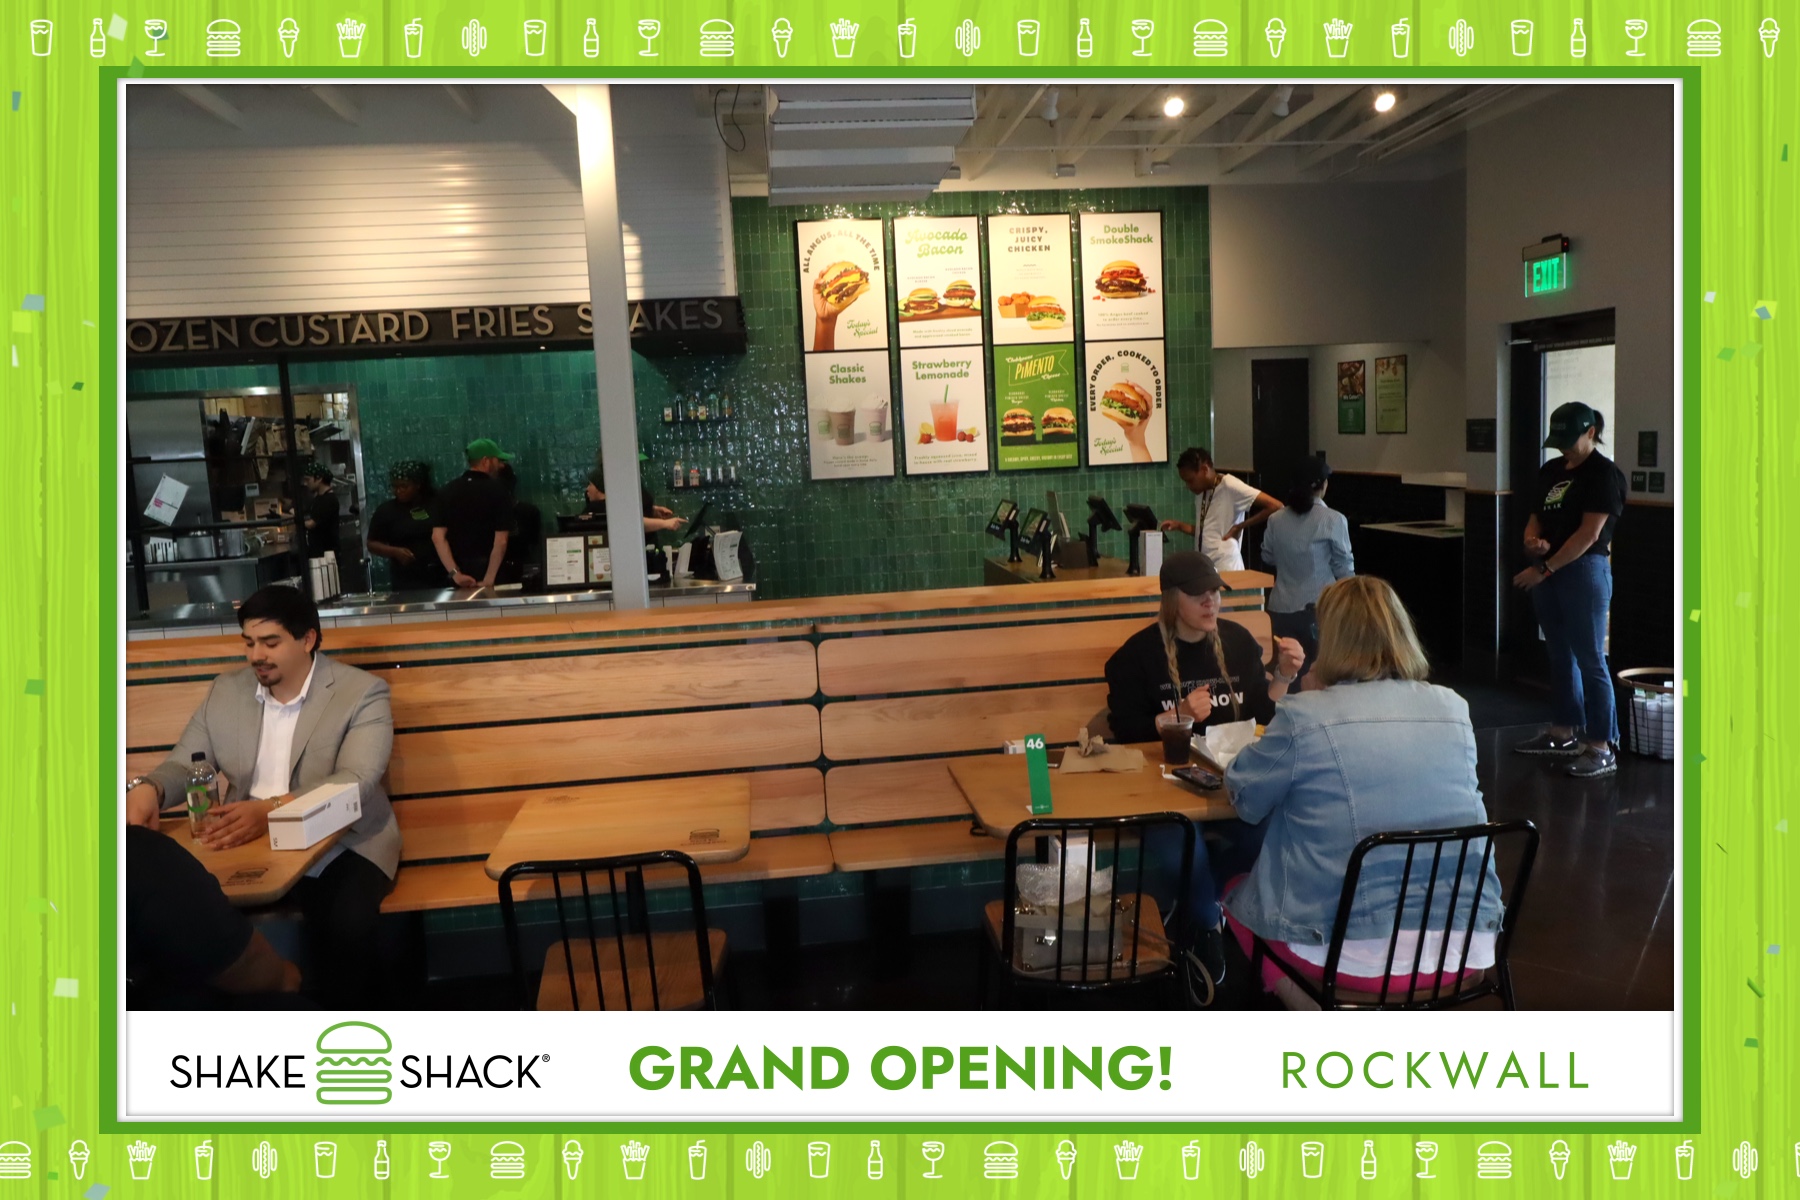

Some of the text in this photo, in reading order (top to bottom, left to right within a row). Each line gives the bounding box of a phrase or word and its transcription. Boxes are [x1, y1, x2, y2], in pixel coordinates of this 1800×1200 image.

[1009, 226, 1048, 235] CRISPY,
[1103, 223, 1139, 234] Double
[905, 228, 968, 244] Avocado
[1090, 234, 1153, 245] SmokeShack
[803, 230, 880, 273] ALL ANGUS, ALL THE TIME
[917, 244, 964, 258] Bacon
[1008, 245, 1051, 253] CHICKEN
[1533, 257, 1560, 293] EXIT
[250, 309, 430, 347] CUSTARD
[451, 304, 554, 339] FRIES
[576, 299, 724, 333] SAKES
[830, 363, 864, 374] Classic
[912, 359, 972, 370] Strawberry
[1092, 354, 1115, 382] ORDER,
[1117, 350, 1152, 366] COOKED
[1150, 365, 1159, 377] TO
[829, 374, 867, 385] Shakes
[915, 369, 969, 380] Lemonade
[1099, 444, 1123, 456] Special
[1633, 474, 1644, 482] EXIT
[1026, 737, 1044, 750] 46
